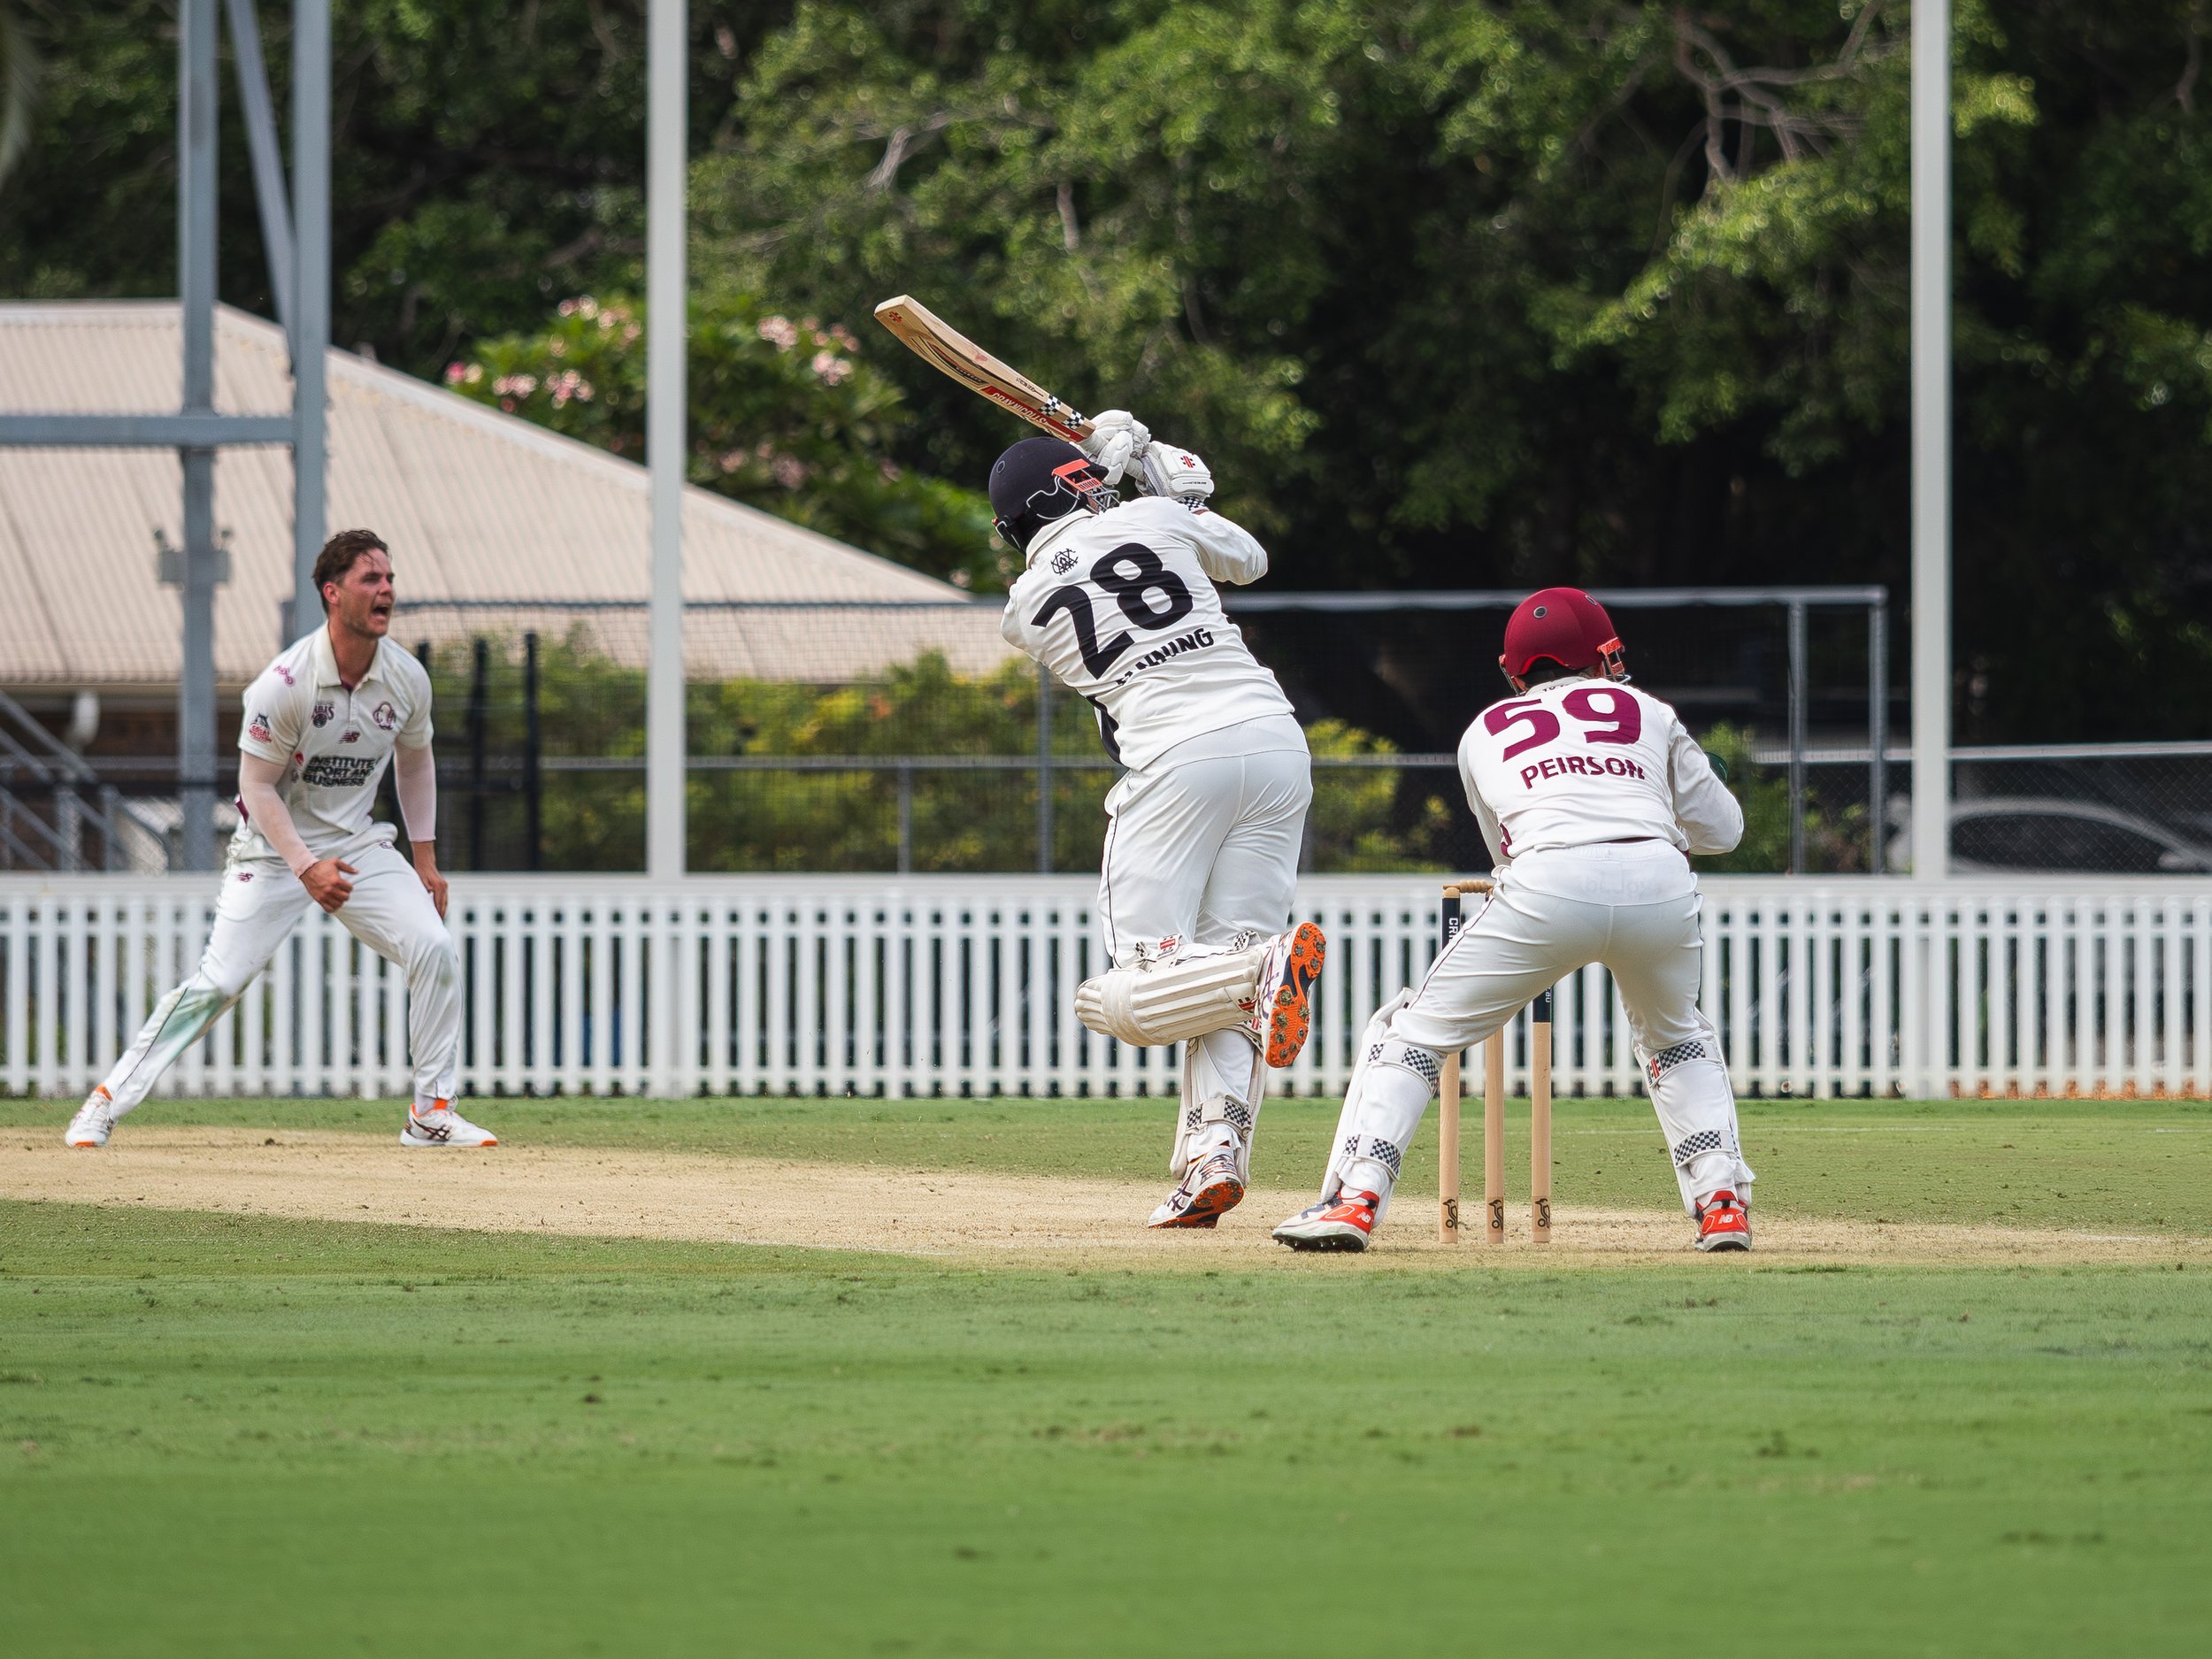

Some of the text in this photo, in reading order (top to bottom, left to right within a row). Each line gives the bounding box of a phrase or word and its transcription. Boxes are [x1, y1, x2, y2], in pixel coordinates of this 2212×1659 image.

[1031, 542, 1194, 680] 28
[1484, 688, 1642, 763] 59
[303, 764, 350, 778] SPORT
[309, 755, 375, 769] INSTITUTE
[1519, 756, 1646, 790] PEIRSON
[303, 774, 366, 787] BUSINESS
